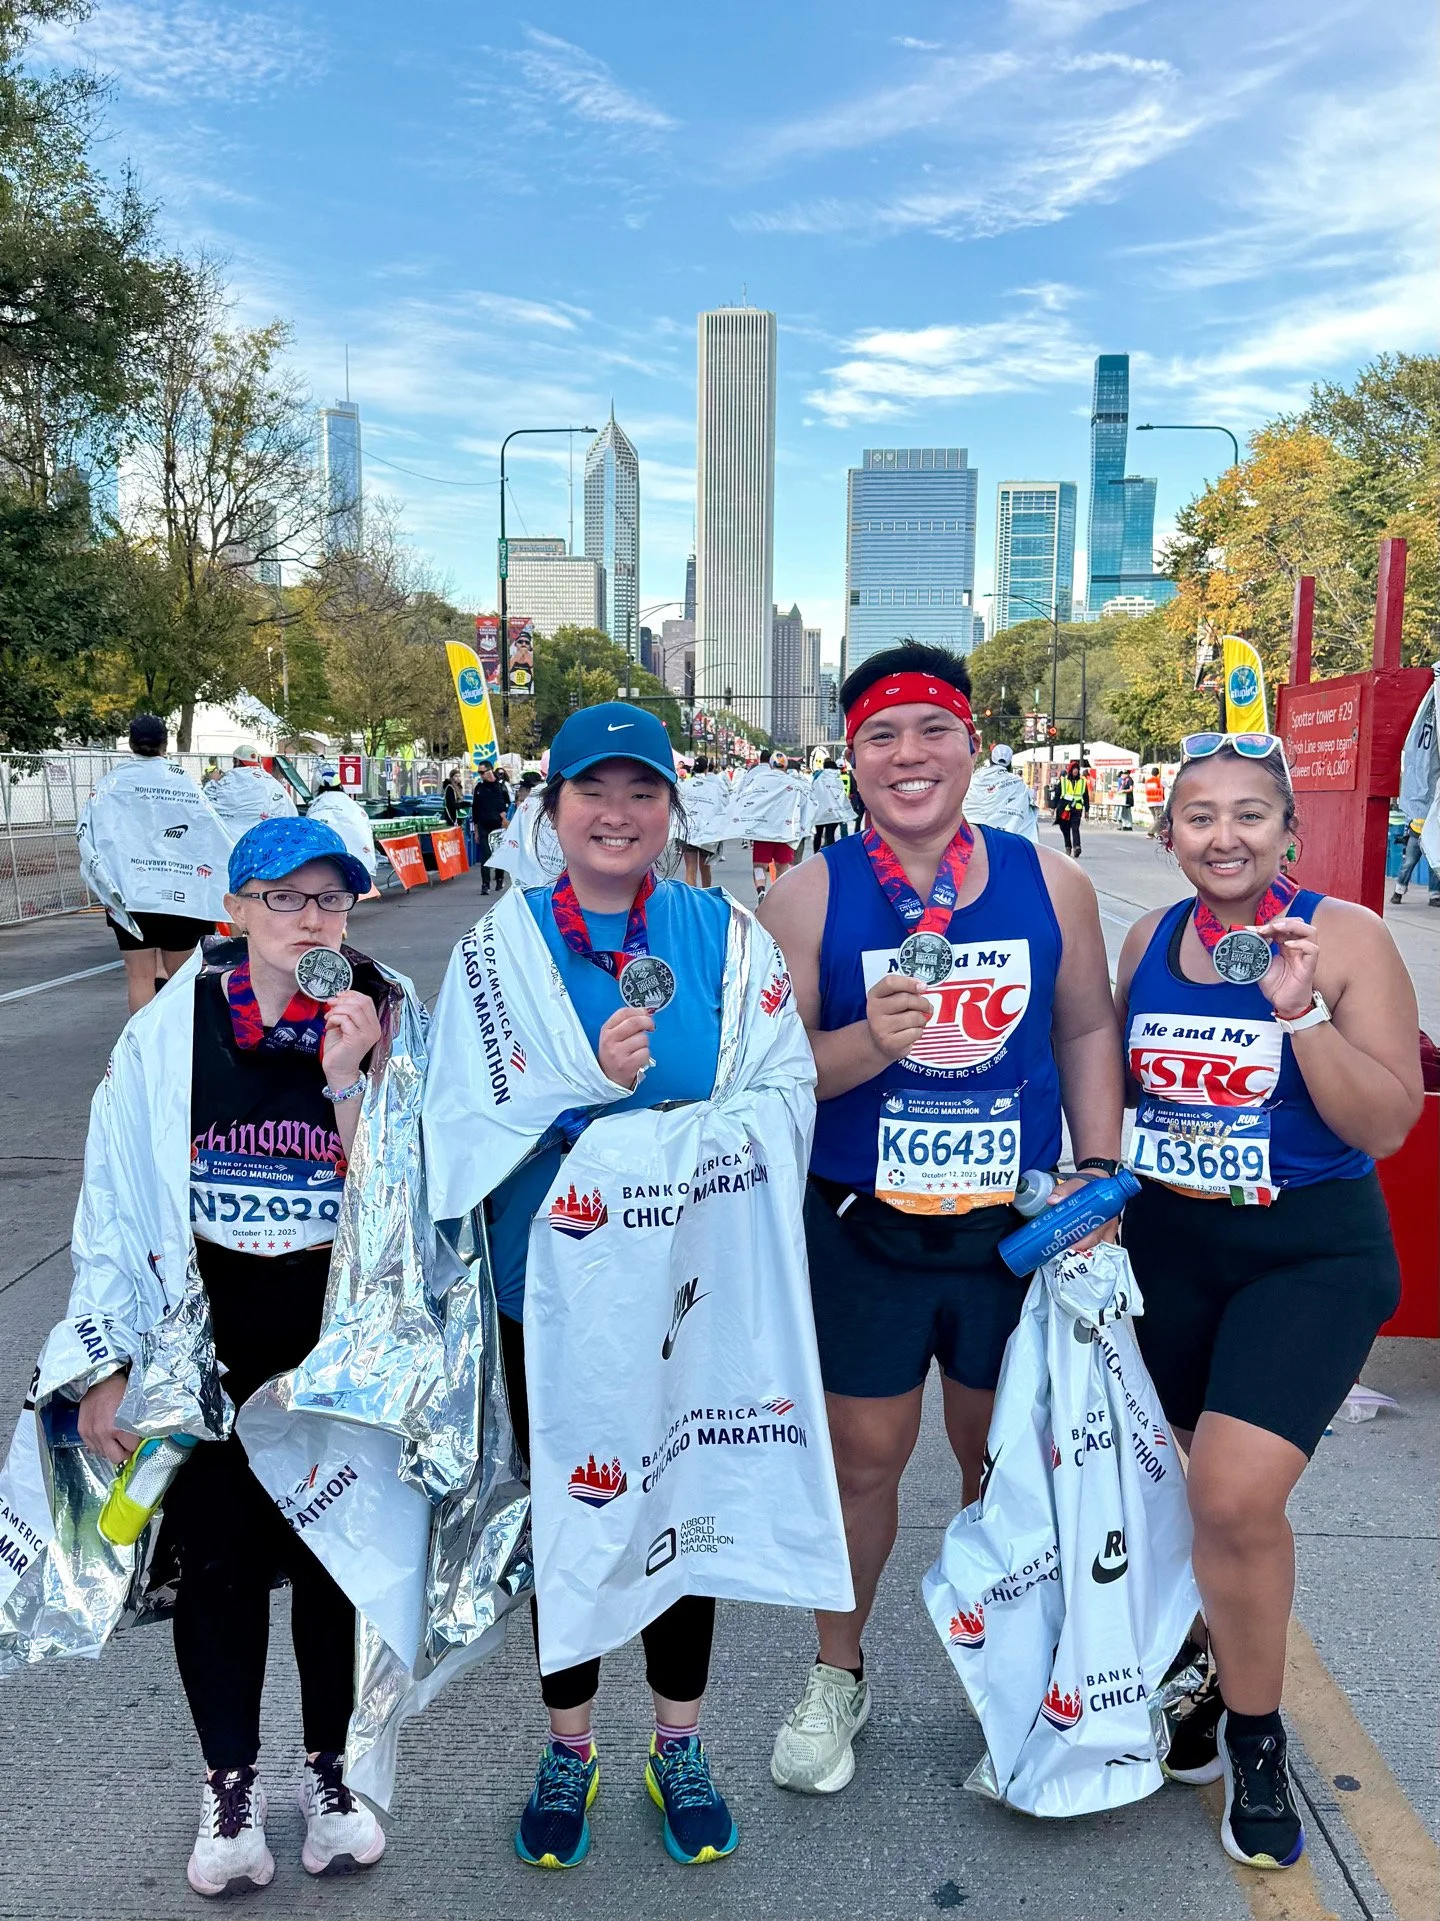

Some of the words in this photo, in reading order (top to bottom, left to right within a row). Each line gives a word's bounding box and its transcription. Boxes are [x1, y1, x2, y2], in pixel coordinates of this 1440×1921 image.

[1291, 711, 1314, 732] Spotter
[1316, 708, 1336, 725] tower
[1317, 740, 1335, 754] sweep
[1336, 737, 1352, 751] team
[163, 828, 183, 839] RUN
[484, 946, 496, 966] OF
[976, 950, 1011, 968] My
[486, 967, 513, 1041] AMERICA
[1142, 1023, 1167, 1037] Me
[1172, 1027, 1216, 1041] and
[1220, 1028, 1260, 1047] My
[473, 992, 511, 1106] MARATHON
[897, 1056, 923, 1076] AMILY
[925, 1068, 954, 1079] STYLE
[956, 1069, 969, 1078] RC
[976, 1062, 993, 1074] EST.
[994, 1047, 1008, 1064] 2022
[908, 1106, 939, 1115] CHICAGO
[941, 1106, 980, 1115] MARATHON
[994, 1098, 1013, 1108] RUN
[1237, 1115, 1260, 1124] RUN
[882, 1126, 1016, 1166] K66439
[1134, 1135, 1264, 1181] L63689
[212, 1167, 248, 1177] CHICAGO
[249, 1170, 294, 1182] MARATHON
[313, 1169, 337, 1179] RUN
[922, 1171, 947, 1179] October
[979, 1170, 1014, 1187] HUY
[622, 1184, 674, 1199] BANK
[886, 1199, 904, 1207] ROW
[232, 1229, 261, 1237] October
[263, 1229, 275, 1237] 12,
[277, 1228, 297, 1236] 2025
[641, 1436, 669, 1468] BANK
[668, 1420, 681, 1438] OF
[681, 1407, 758, 1426] AMERICA
[641, 1432, 691, 1494] CHICAGO
[697, 1424, 808, 1449] MARATHON
[680, 1516, 717, 1532] ABBOTT
[680, 1525, 715, 1539] WORLD
[680, 1534, 734, 1548] MARATHON
[680, 1544, 718, 1556] MAJORS
[1022, 1558, 1041, 1576] OF
[1086, 1667, 1132, 1687] BANK
[1089, 1684, 1147, 1713] CHICA
